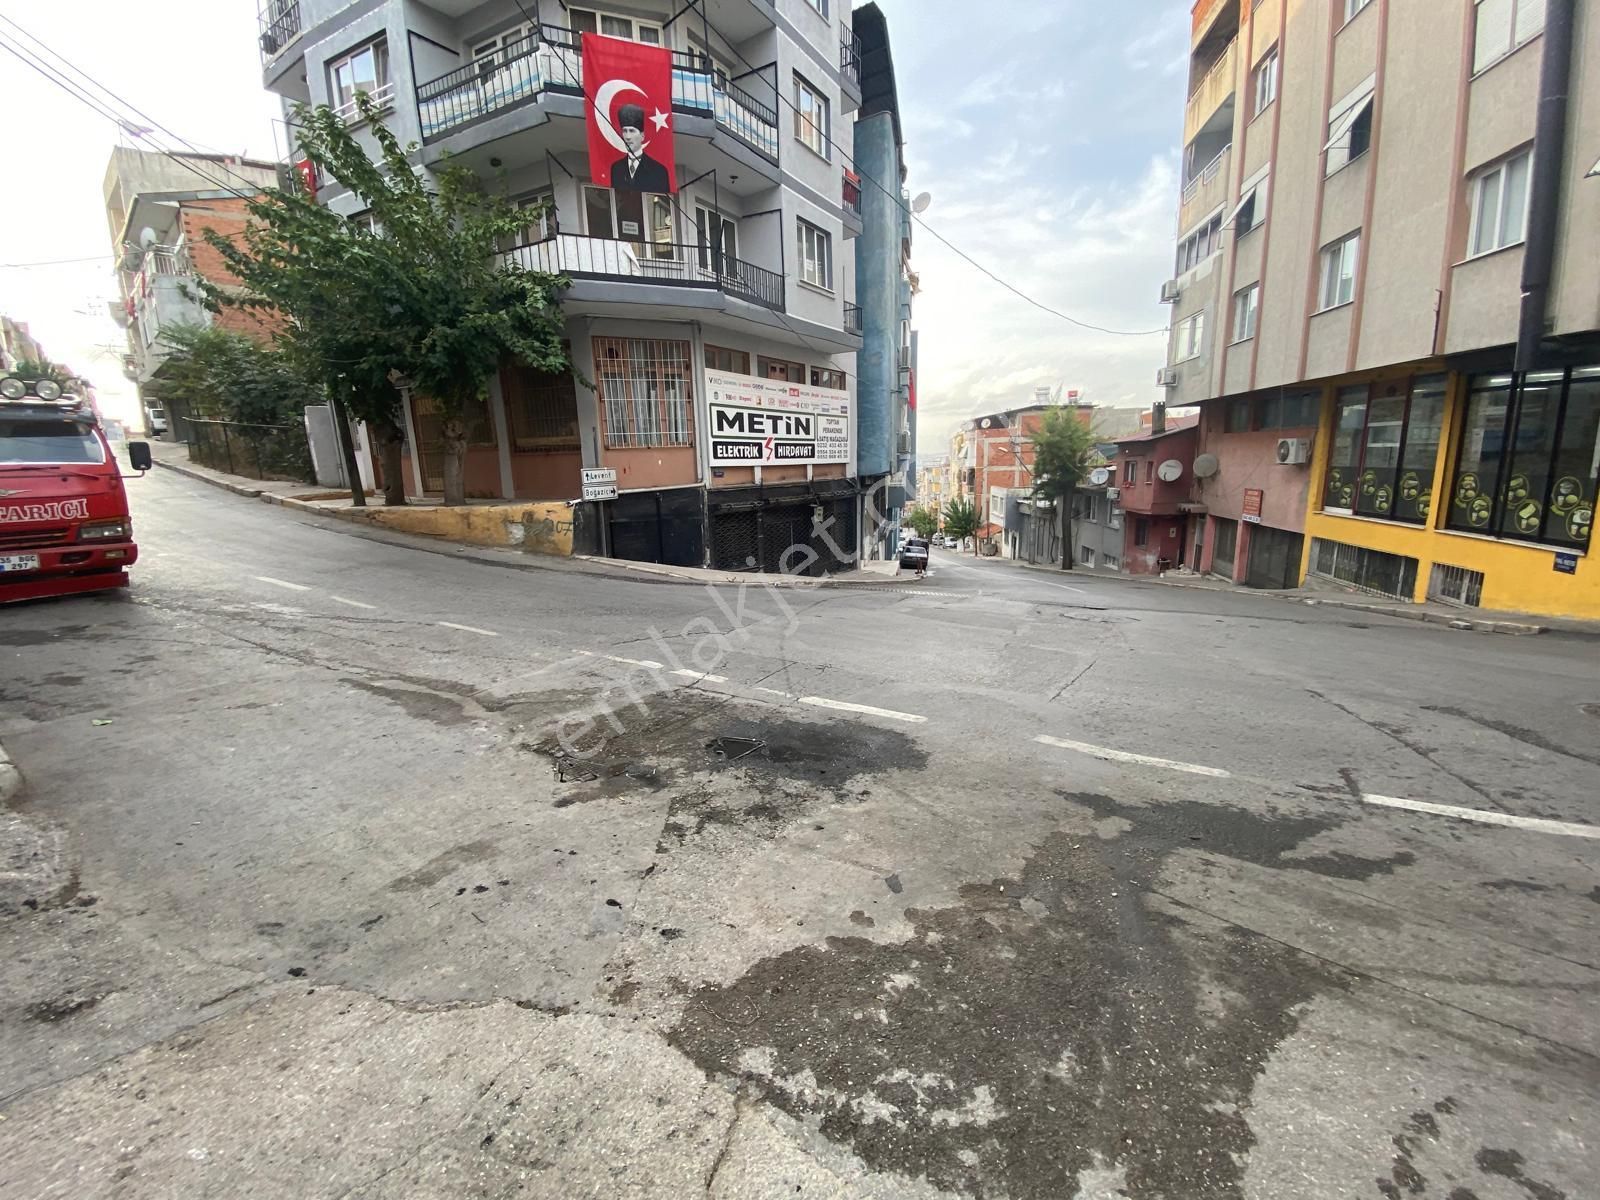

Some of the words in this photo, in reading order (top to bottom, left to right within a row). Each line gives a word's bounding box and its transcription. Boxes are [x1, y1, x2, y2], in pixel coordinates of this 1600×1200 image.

[717, 444, 760, 458] ELEKTRİK
[777, 445, 812, 457] HIRDAVAT
[590, 471, 612, 480] Levent
[11, 562, 29, 570] 297
